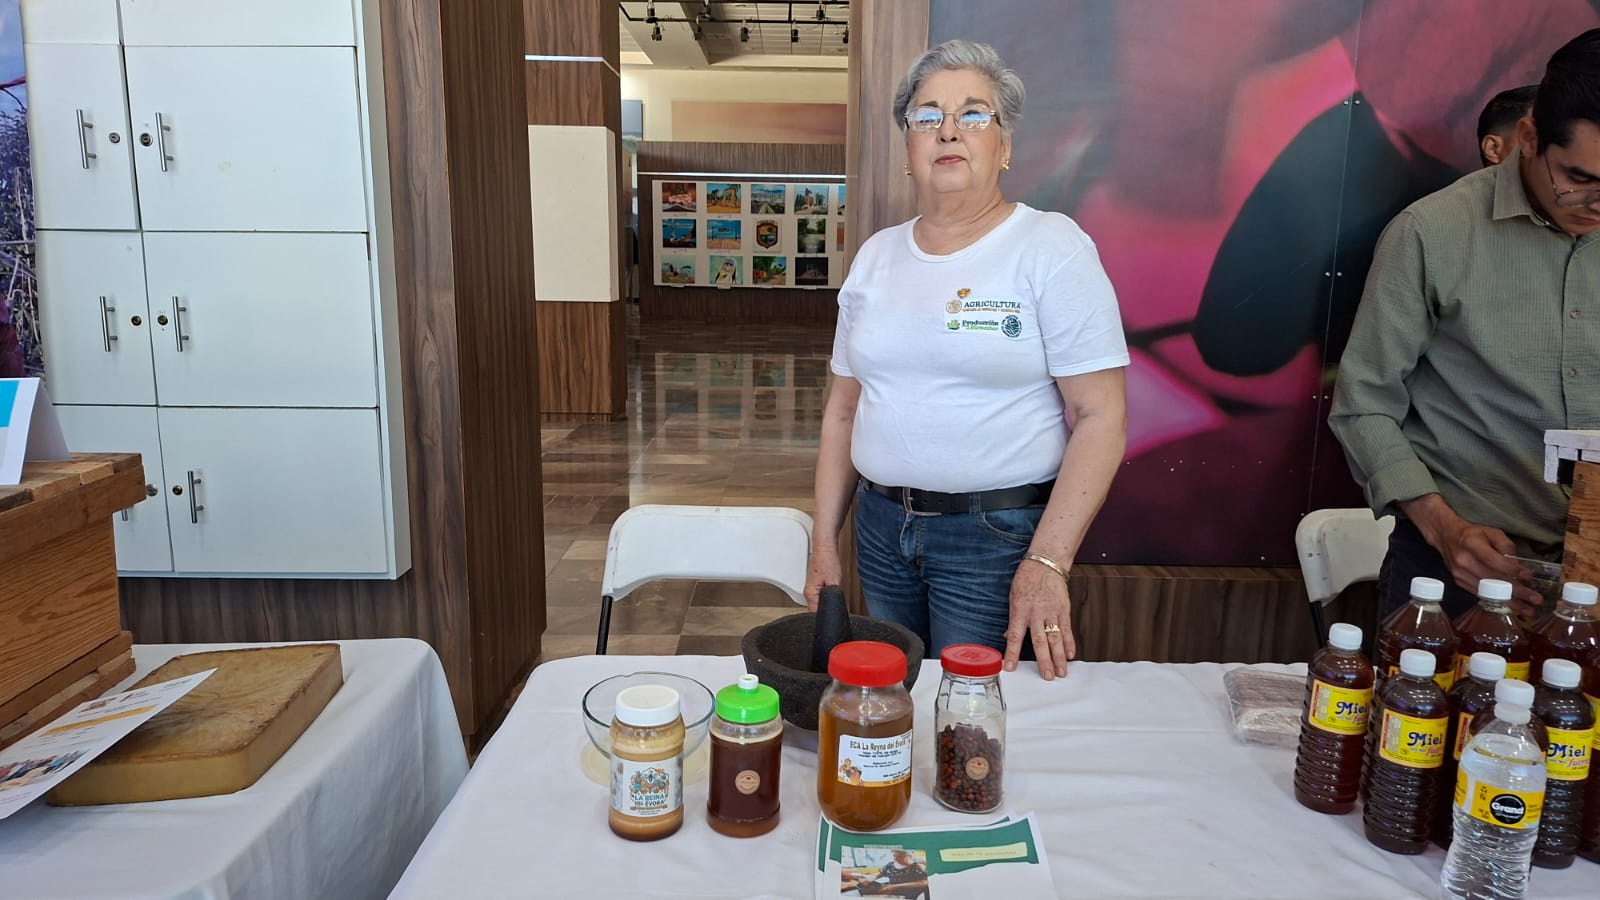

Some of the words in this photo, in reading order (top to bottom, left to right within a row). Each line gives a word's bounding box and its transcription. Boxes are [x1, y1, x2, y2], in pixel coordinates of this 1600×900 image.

[964, 301, 1021, 309] AGRICULTURA
[1335, 701, 1368, 715] Miel
[850, 741, 861, 749] ECA
[862, 742, 869, 750] La
[1406, 731, 1443, 747] Miel
[1547, 742, 1586, 758] Miel
[1491, 801, 1525, 815] Grand
